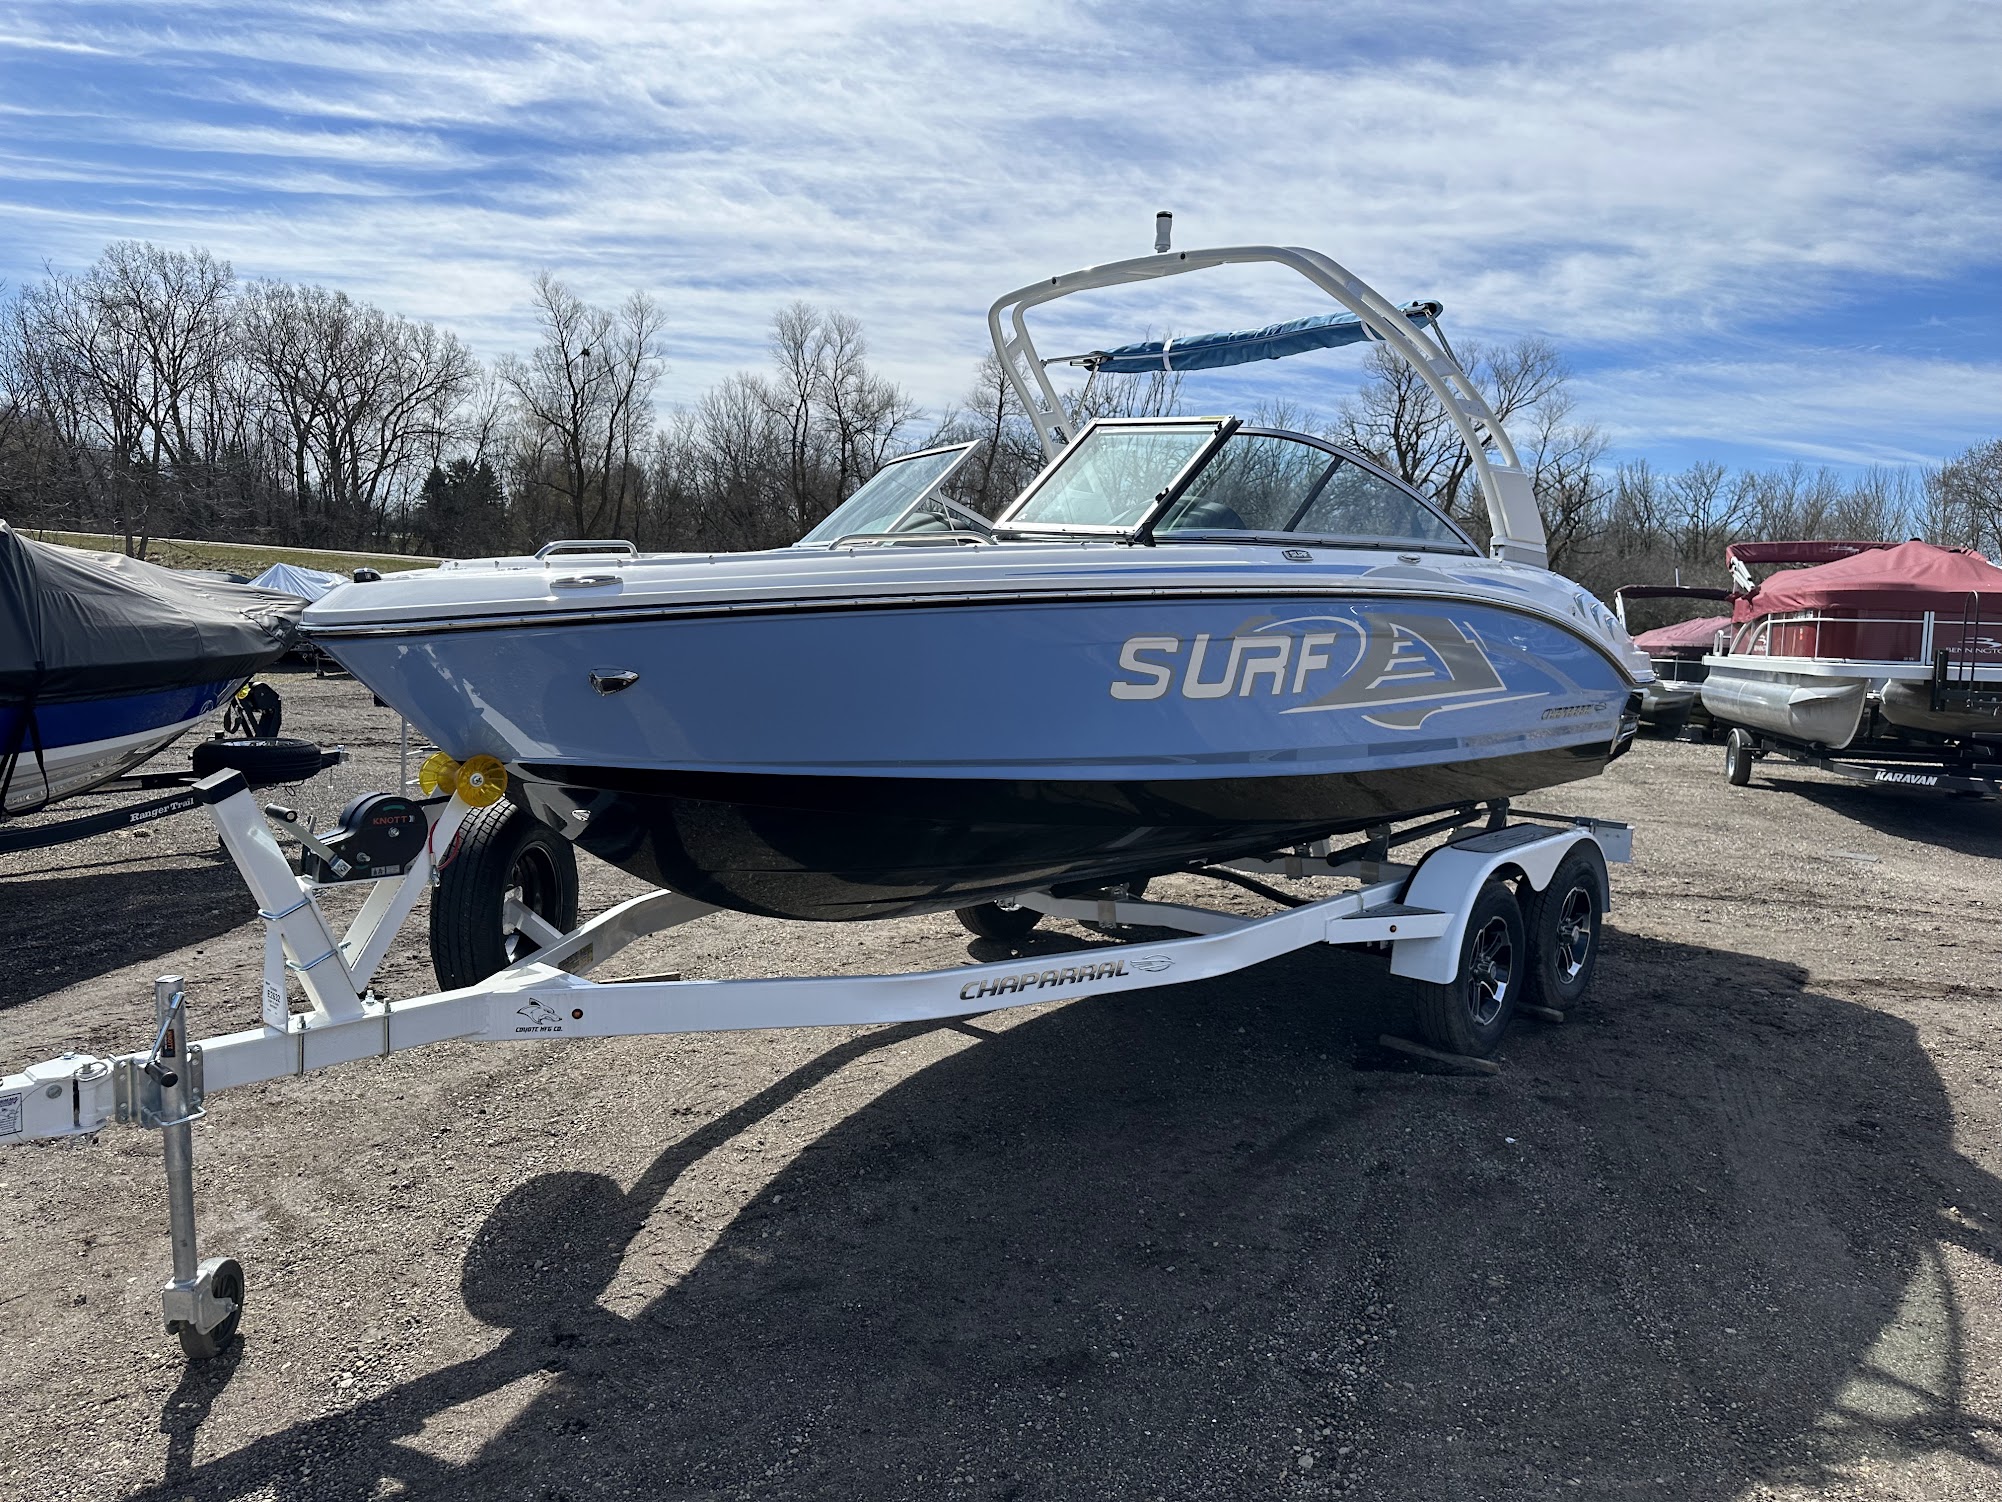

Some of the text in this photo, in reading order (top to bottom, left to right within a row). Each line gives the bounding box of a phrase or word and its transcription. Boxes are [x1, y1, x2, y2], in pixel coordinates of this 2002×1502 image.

[1110, 633, 1336, 699] SURF
[1875, 771, 1938, 786] KARAVAN
[129, 797, 195, 823] Ranger Trail
[373, 815, 408, 825] KNOTT
[959, 960, 1130, 1000] CHAPARRAL
